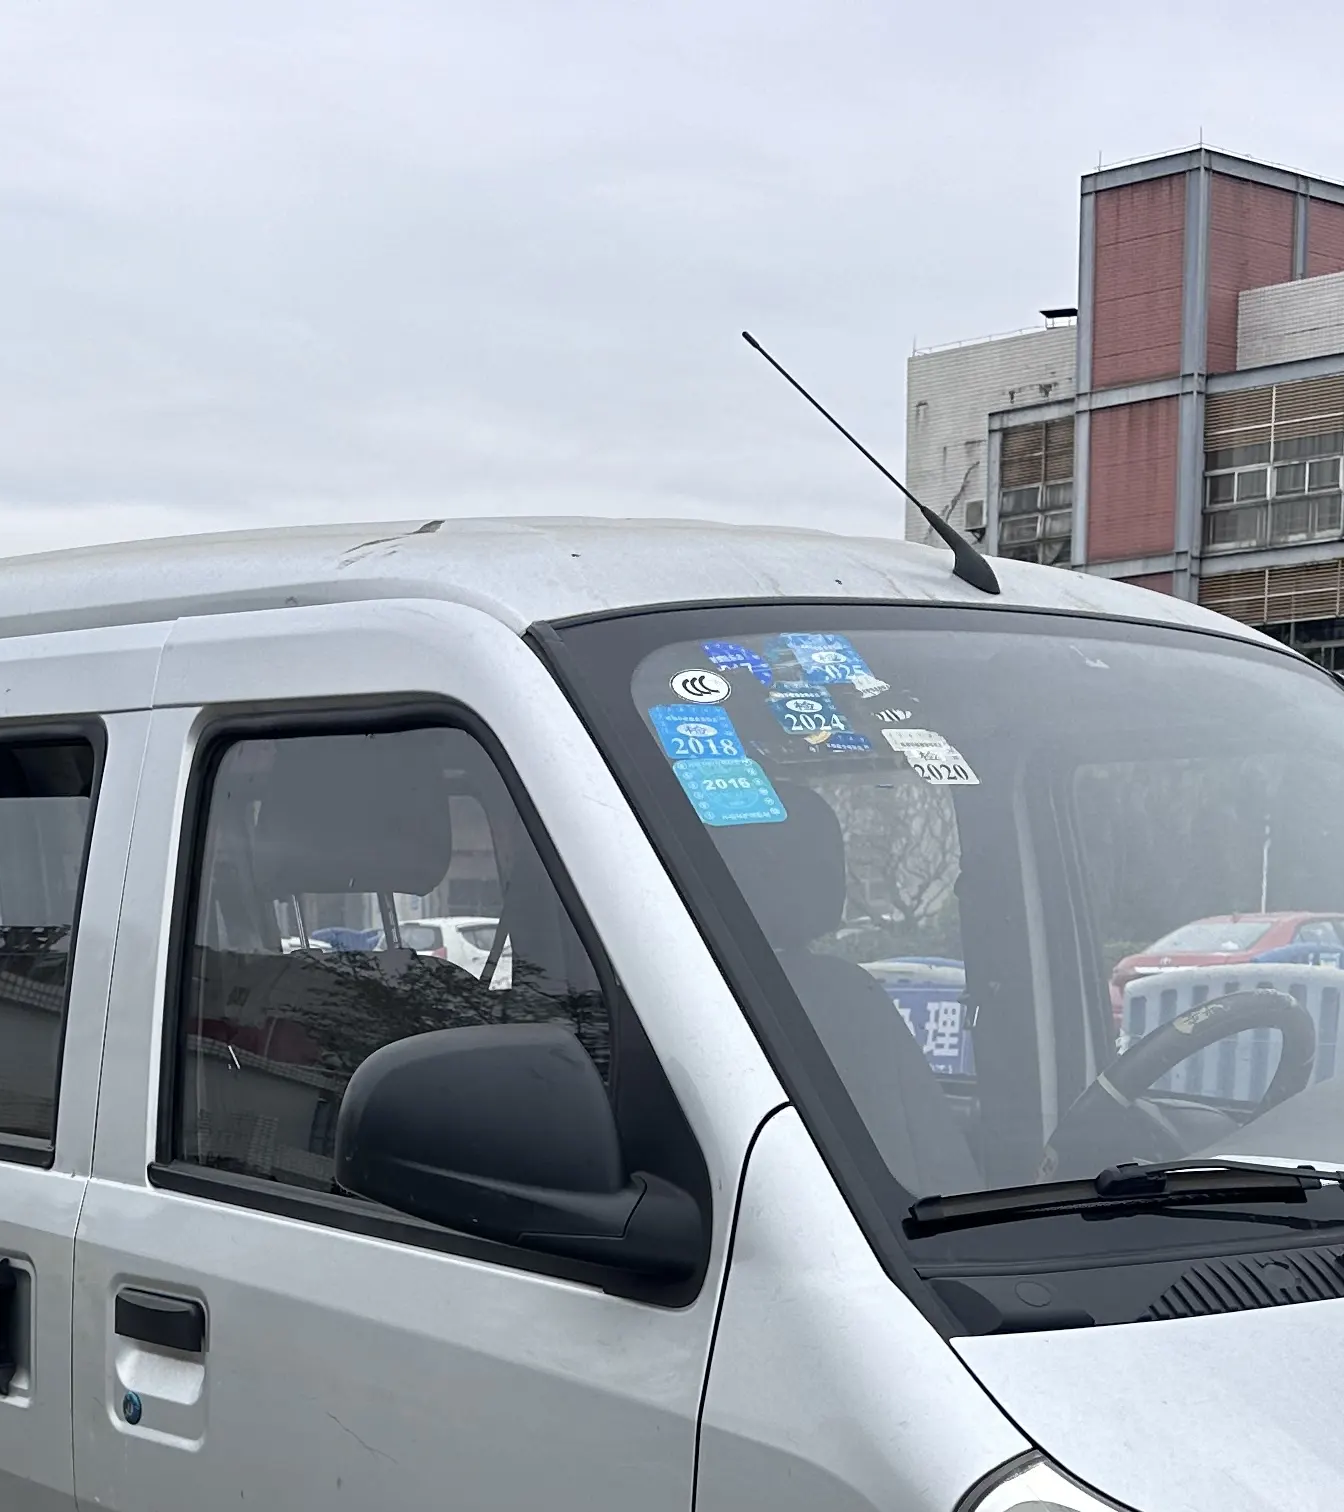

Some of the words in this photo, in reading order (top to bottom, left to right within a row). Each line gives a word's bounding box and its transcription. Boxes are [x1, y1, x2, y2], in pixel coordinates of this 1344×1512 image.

[784, 713, 846, 732] 2024
[670, 737, 738, 756] 2018
[913, 763, 969, 782] 2020
[702, 776, 751, 791] 2016
